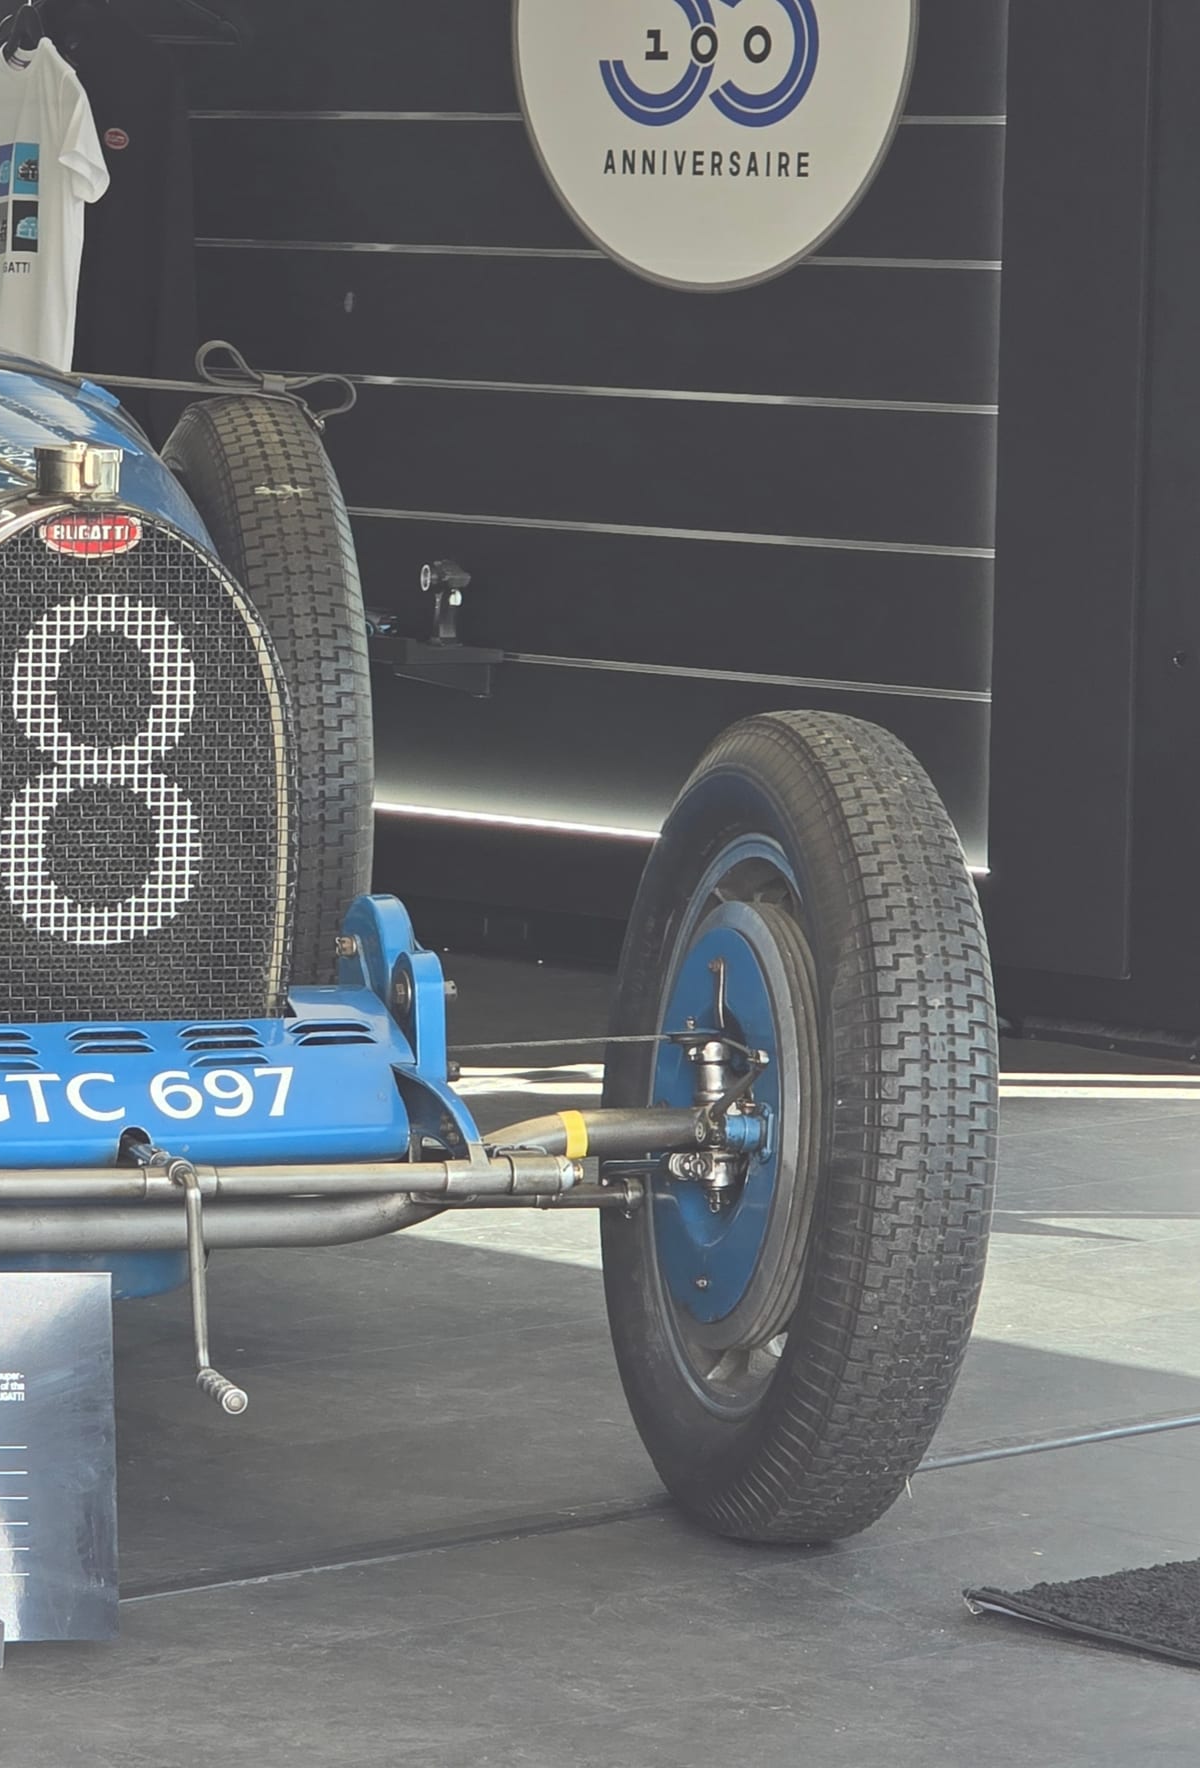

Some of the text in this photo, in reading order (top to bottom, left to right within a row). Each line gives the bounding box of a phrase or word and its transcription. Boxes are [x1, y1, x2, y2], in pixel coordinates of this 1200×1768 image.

[645, 25, 772, 63] 100
[603, 149, 810, 177] ANNIVERSAIRE
[53, 525, 129, 540] BUGATTI
[0, 594, 202, 945] 8
[150, 1066, 294, 1120] 697
